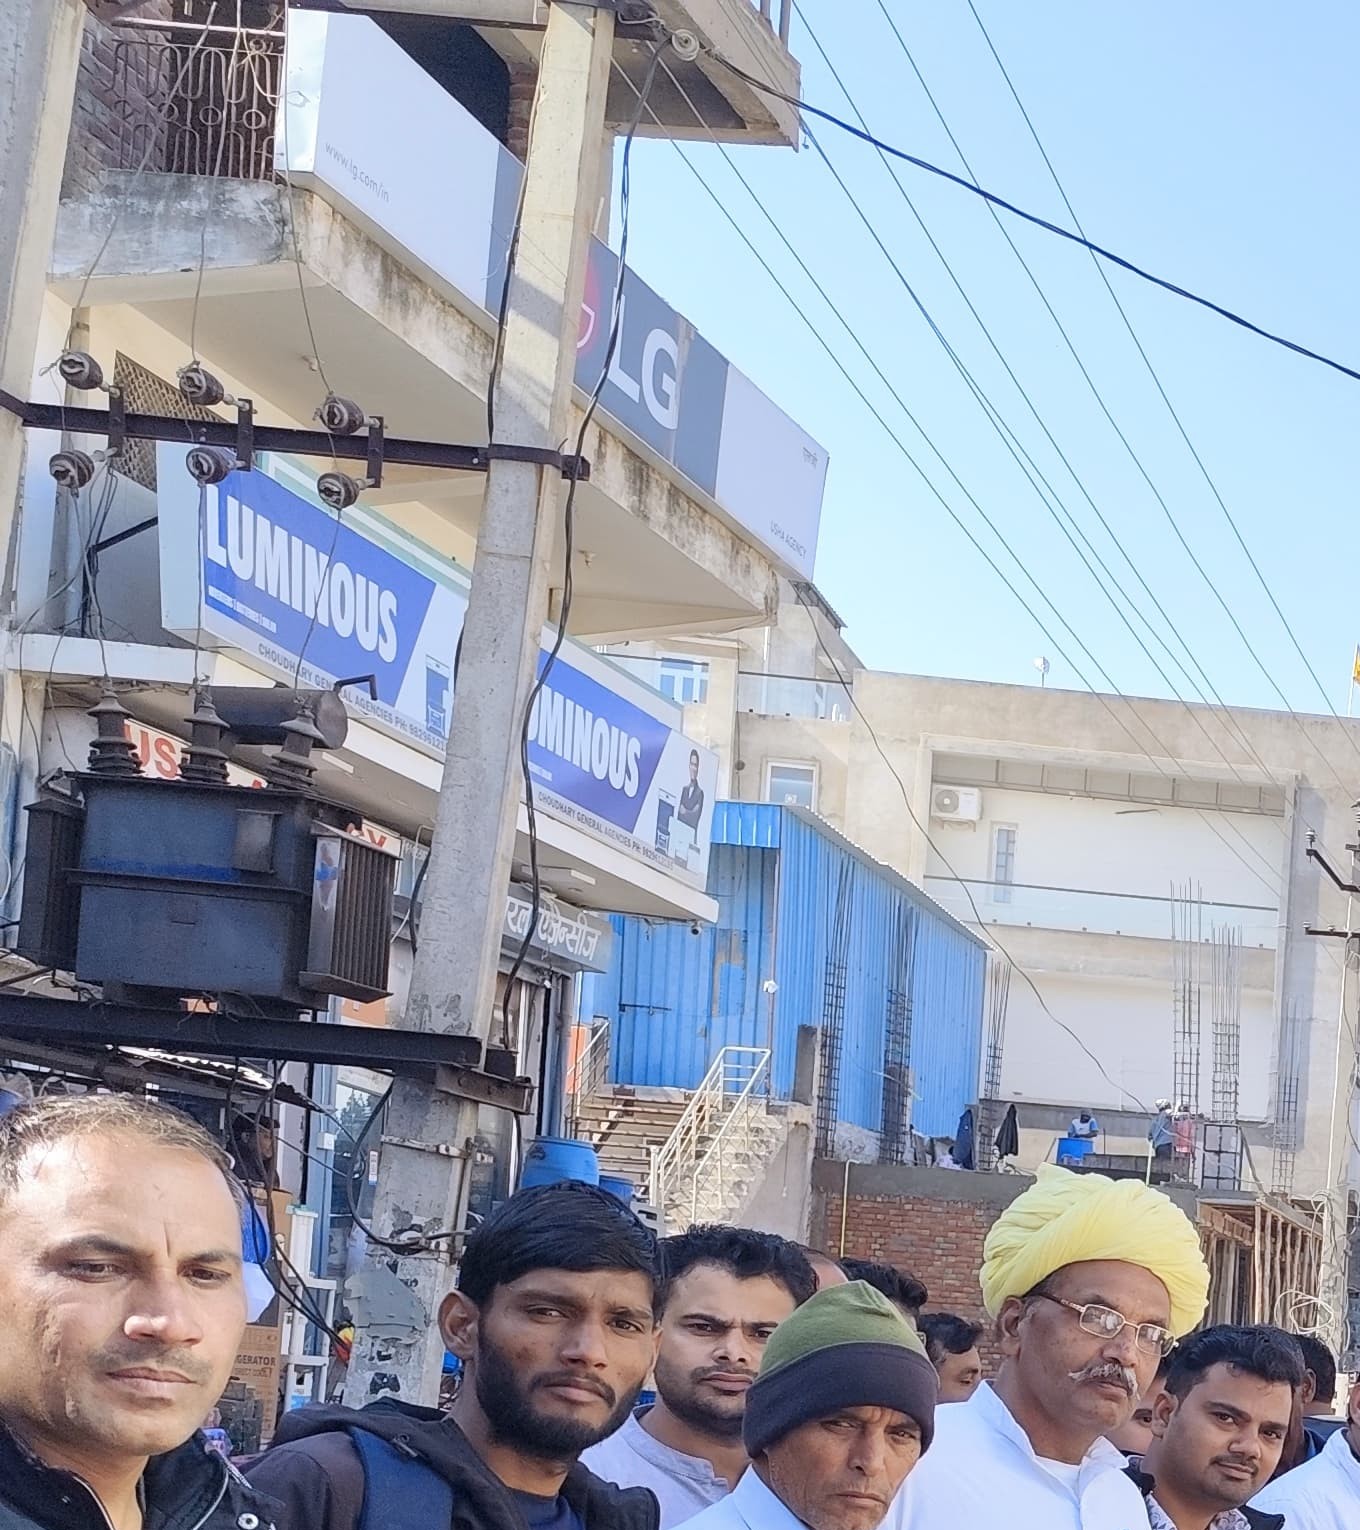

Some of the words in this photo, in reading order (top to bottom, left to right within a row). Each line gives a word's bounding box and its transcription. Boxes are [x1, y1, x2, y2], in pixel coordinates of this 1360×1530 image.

[325, 142, 389, 203] www.lg.com/in
[605, 286, 679, 431] LG
[205, 482, 398, 664] LUMINOUS
[258, 643, 313, 684] CHOUDHRY
[354, 695, 394, 723] AGENCIES
[527, 679, 641, 799] UMINOUS
[538, 791, 576, 818] CHOUDHARY
[576, 811, 604, 833] GENERAL
[604, 826, 632, 849] AGENCIES
